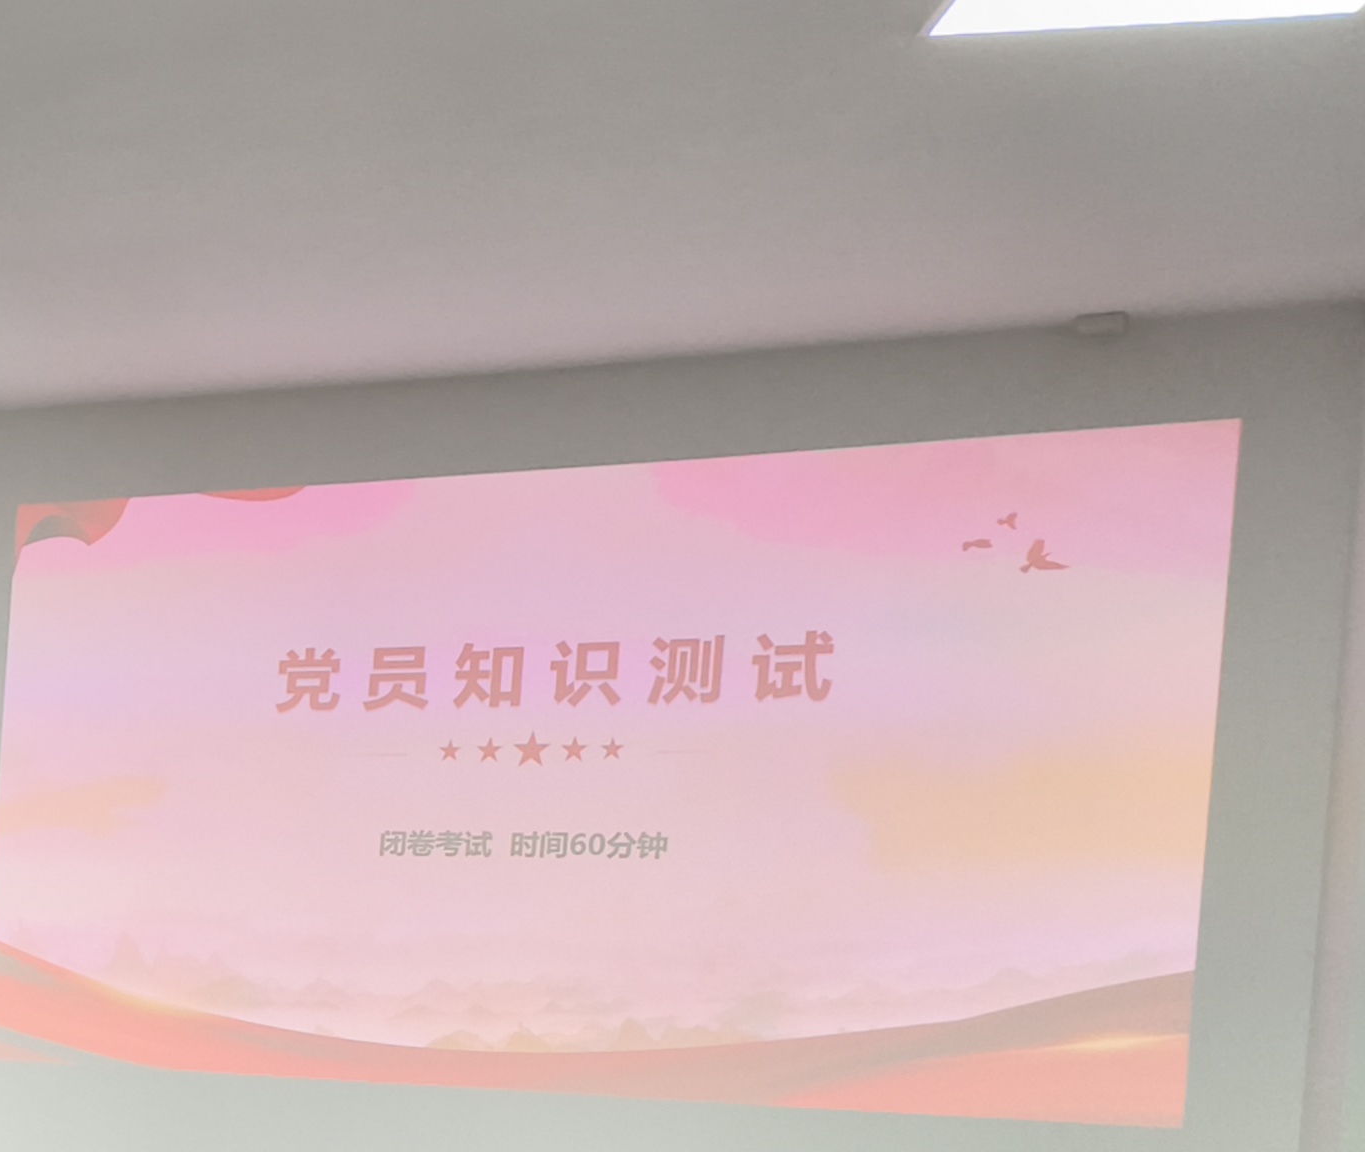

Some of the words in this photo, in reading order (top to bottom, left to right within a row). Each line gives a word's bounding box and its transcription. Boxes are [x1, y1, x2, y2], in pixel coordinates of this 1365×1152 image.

[274, 630, 836, 713] 党员知识测试
[379, 829, 494, 858] 闭卷考试
[510, 831, 669, 860] 时间60分钟
